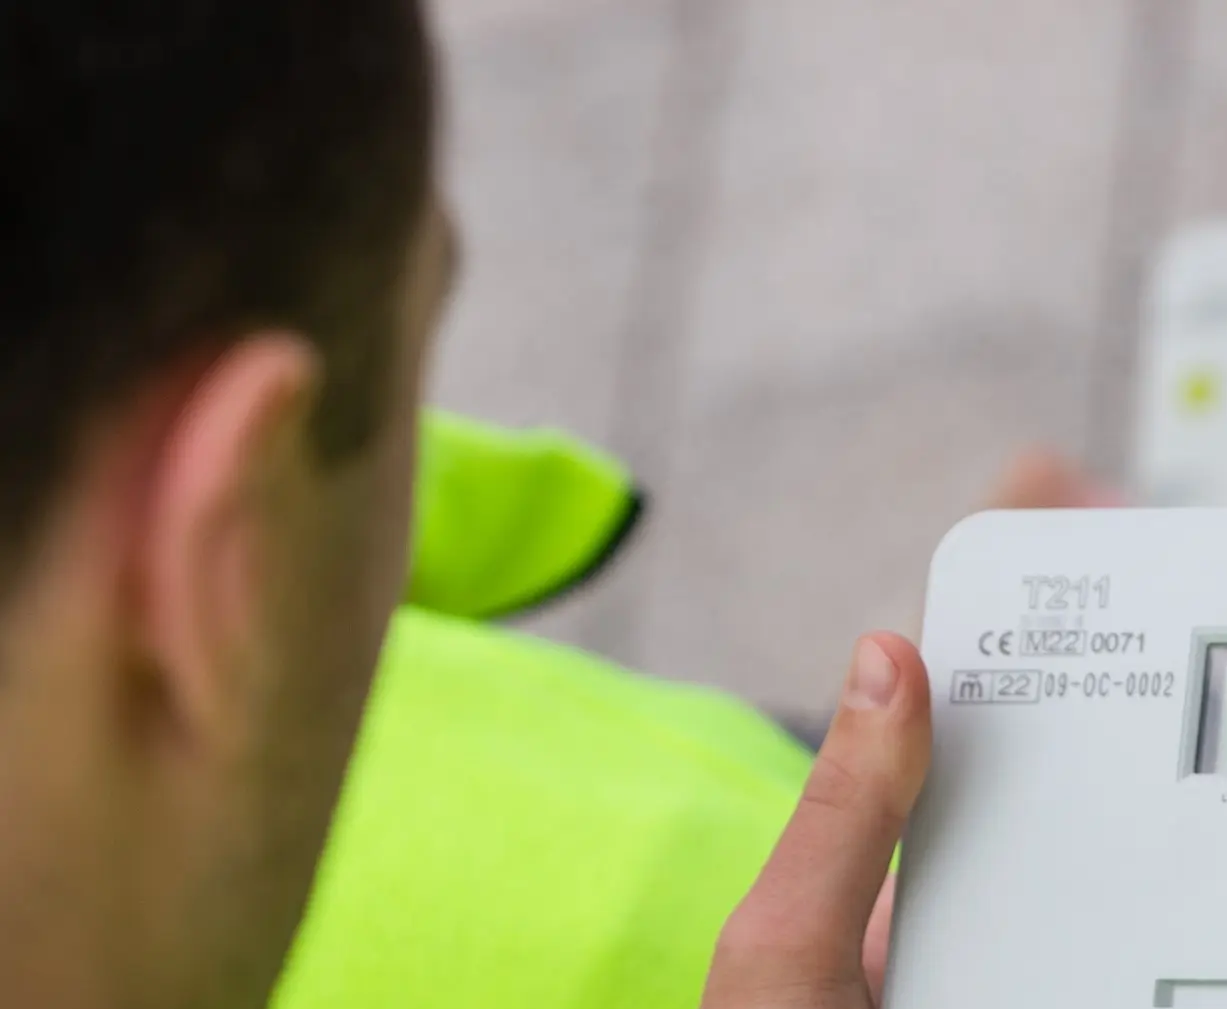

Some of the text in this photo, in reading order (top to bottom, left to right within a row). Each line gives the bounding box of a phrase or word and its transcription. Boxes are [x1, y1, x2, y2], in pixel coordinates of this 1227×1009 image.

[1021, 573, 1112, 610] T211
[1026, 632, 1081, 652] M22
[1089, 631, 1146, 655] 0071
[997, 674, 1031, 697] 22
